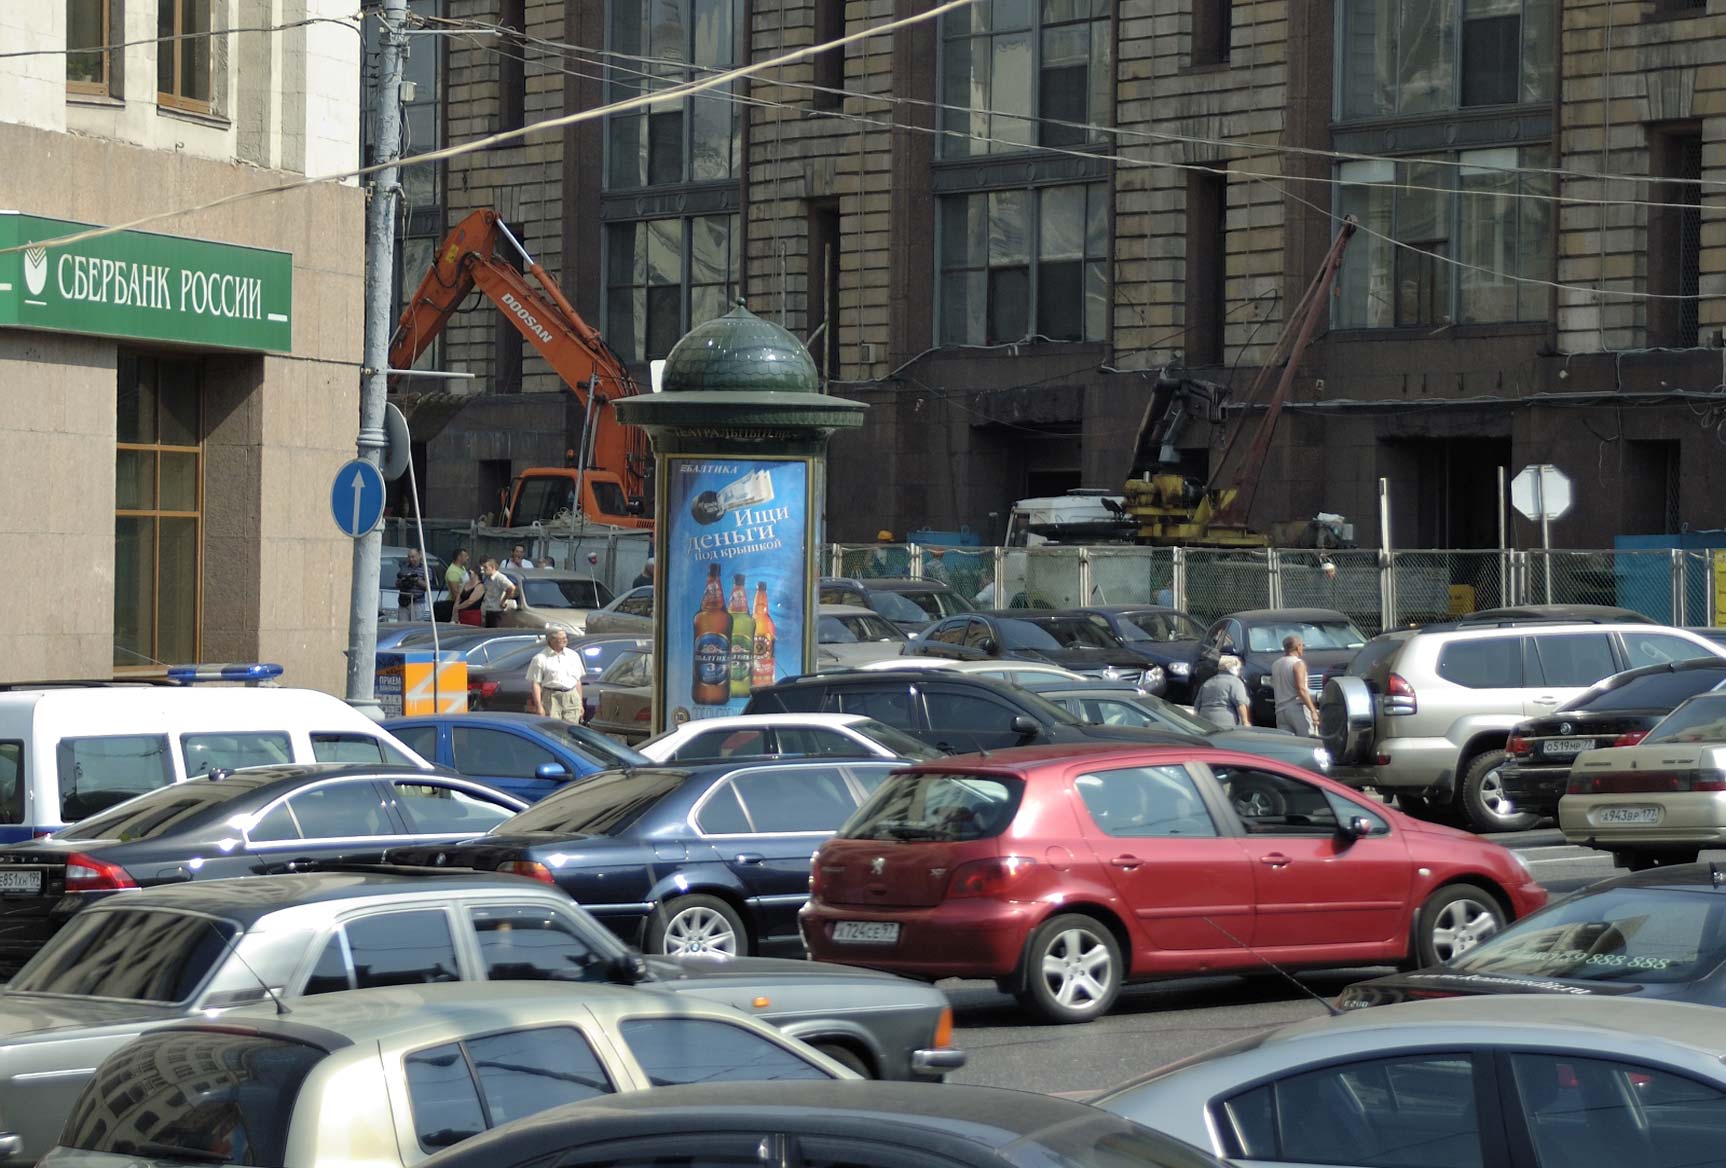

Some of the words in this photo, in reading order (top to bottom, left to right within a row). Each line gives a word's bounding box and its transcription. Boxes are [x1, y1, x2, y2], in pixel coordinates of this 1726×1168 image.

[57, 253, 172, 311] СБЕРБАНК
[180, 268, 263, 321] РОССИИ
[501, 292, 553, 343] DOOSAN
[686, 464, 739, 474] БАЛТИКА
[733, 506, 790, 528] Ищи
[687, 525, 776, 553] деньги
[694, 549, 718, 561] под
[720, 539, 782, 559] крышкой
[1585, 953, 1626, 966] 888
[1627, 956, 1671, 969] 888
